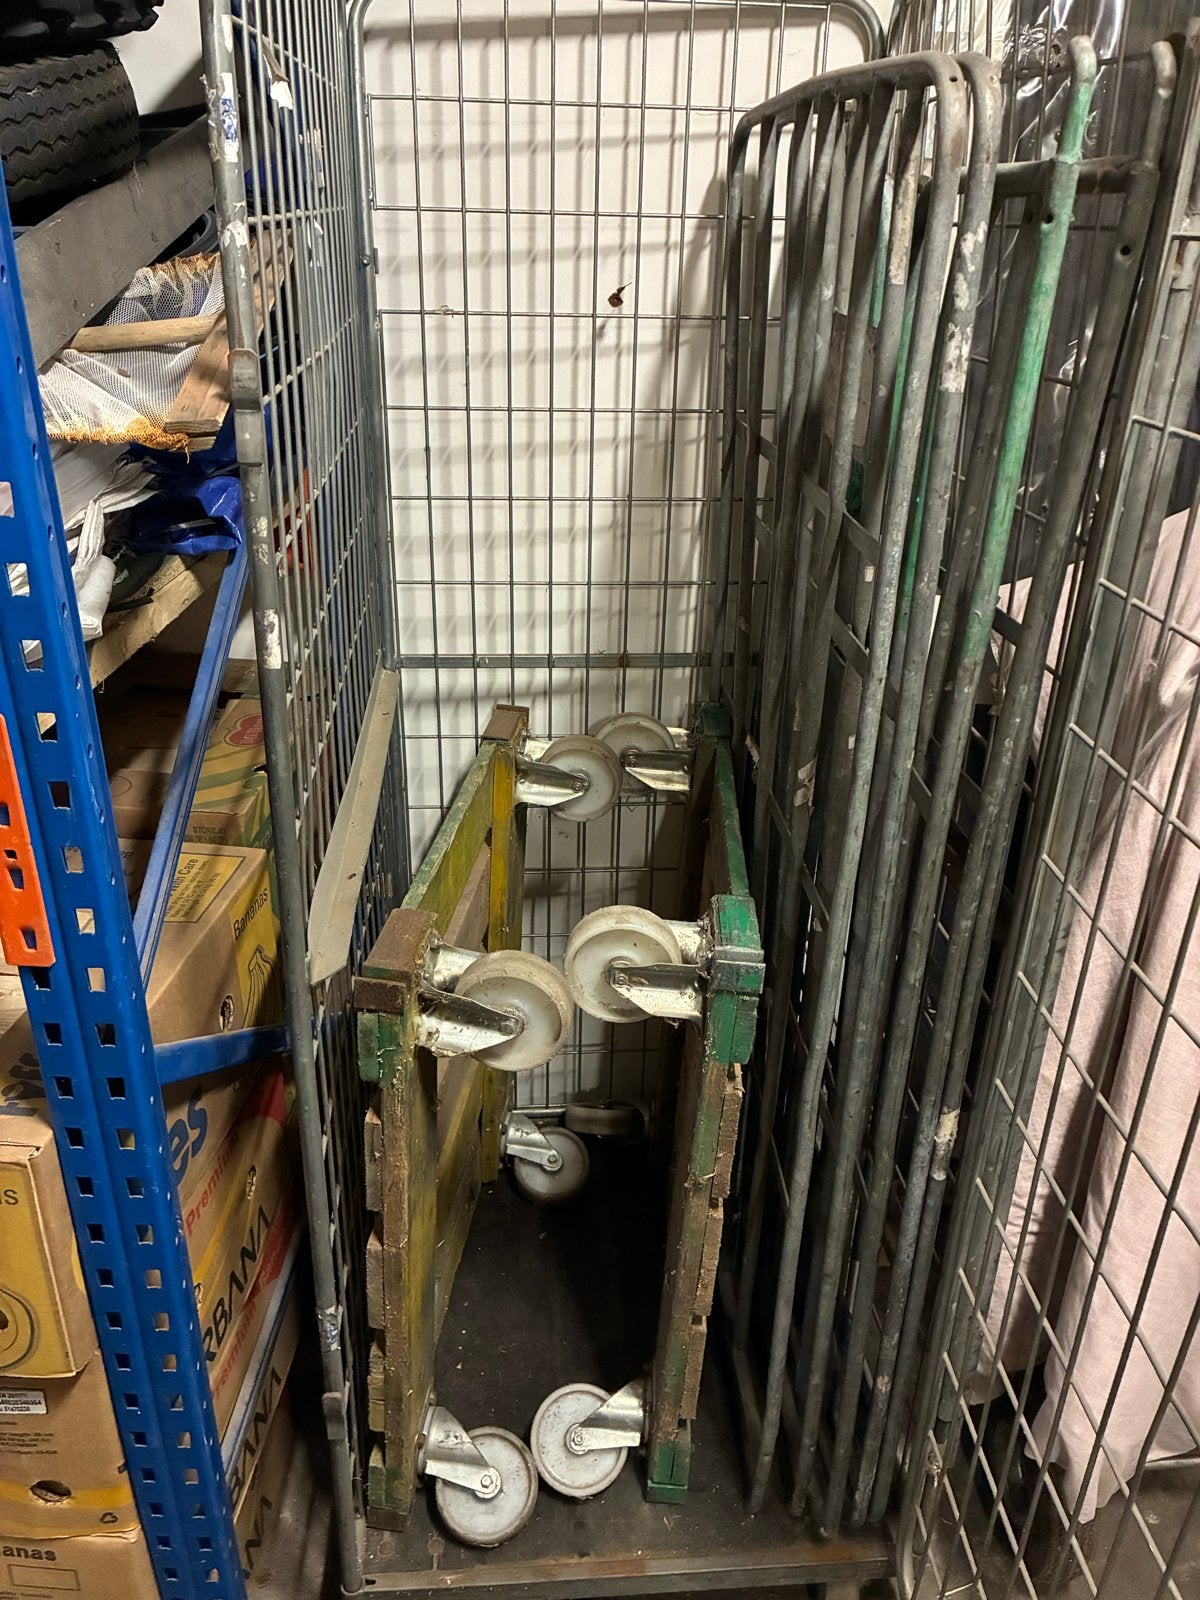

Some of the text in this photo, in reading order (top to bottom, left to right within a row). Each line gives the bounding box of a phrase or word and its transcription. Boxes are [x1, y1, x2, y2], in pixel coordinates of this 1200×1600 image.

[178, 858, 199, 875] Care
[233, 888, 268, 941] Bananas
[186, 1132, 240, 1236] Premium
